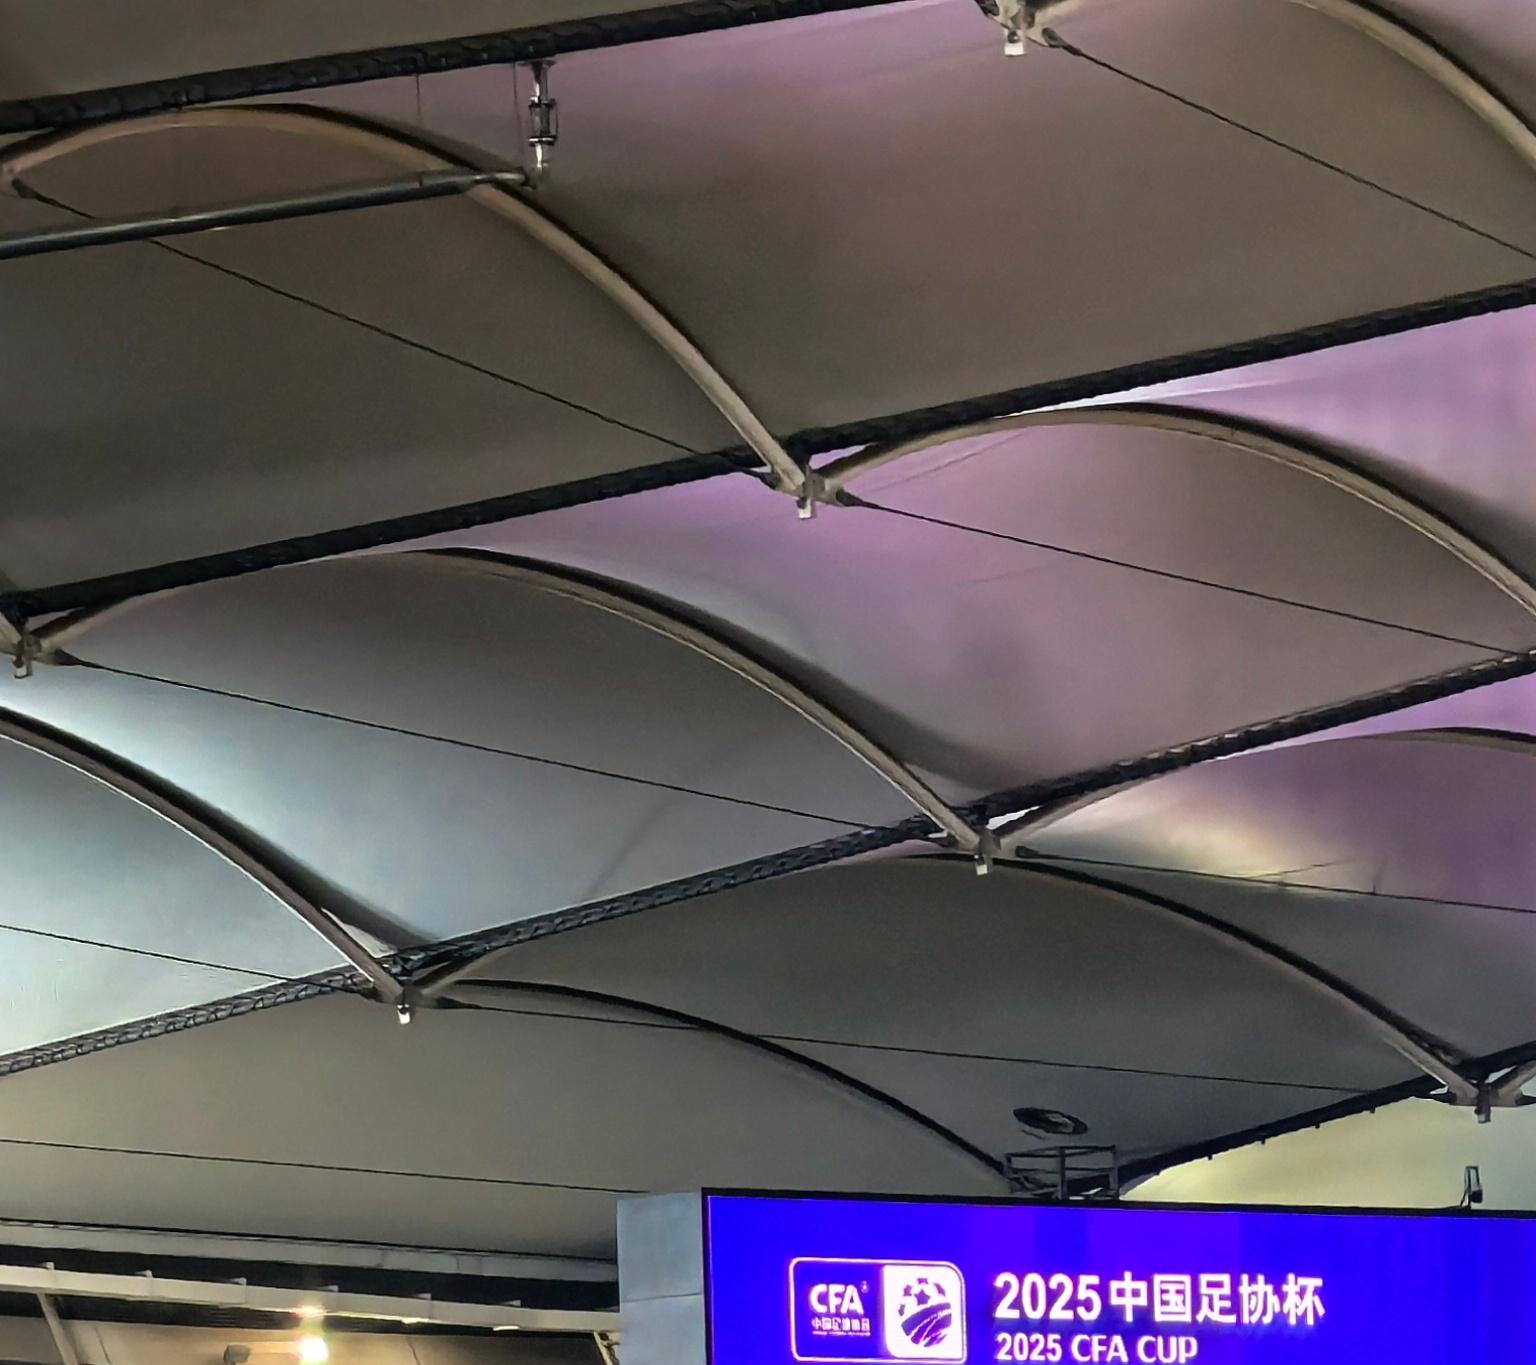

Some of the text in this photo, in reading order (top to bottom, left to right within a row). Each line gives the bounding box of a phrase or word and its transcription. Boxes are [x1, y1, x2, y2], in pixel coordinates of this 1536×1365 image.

[810, 1284, 864, 1314] CFA
[996, 1333, 1198, 1364] 2025 CFA CUP
